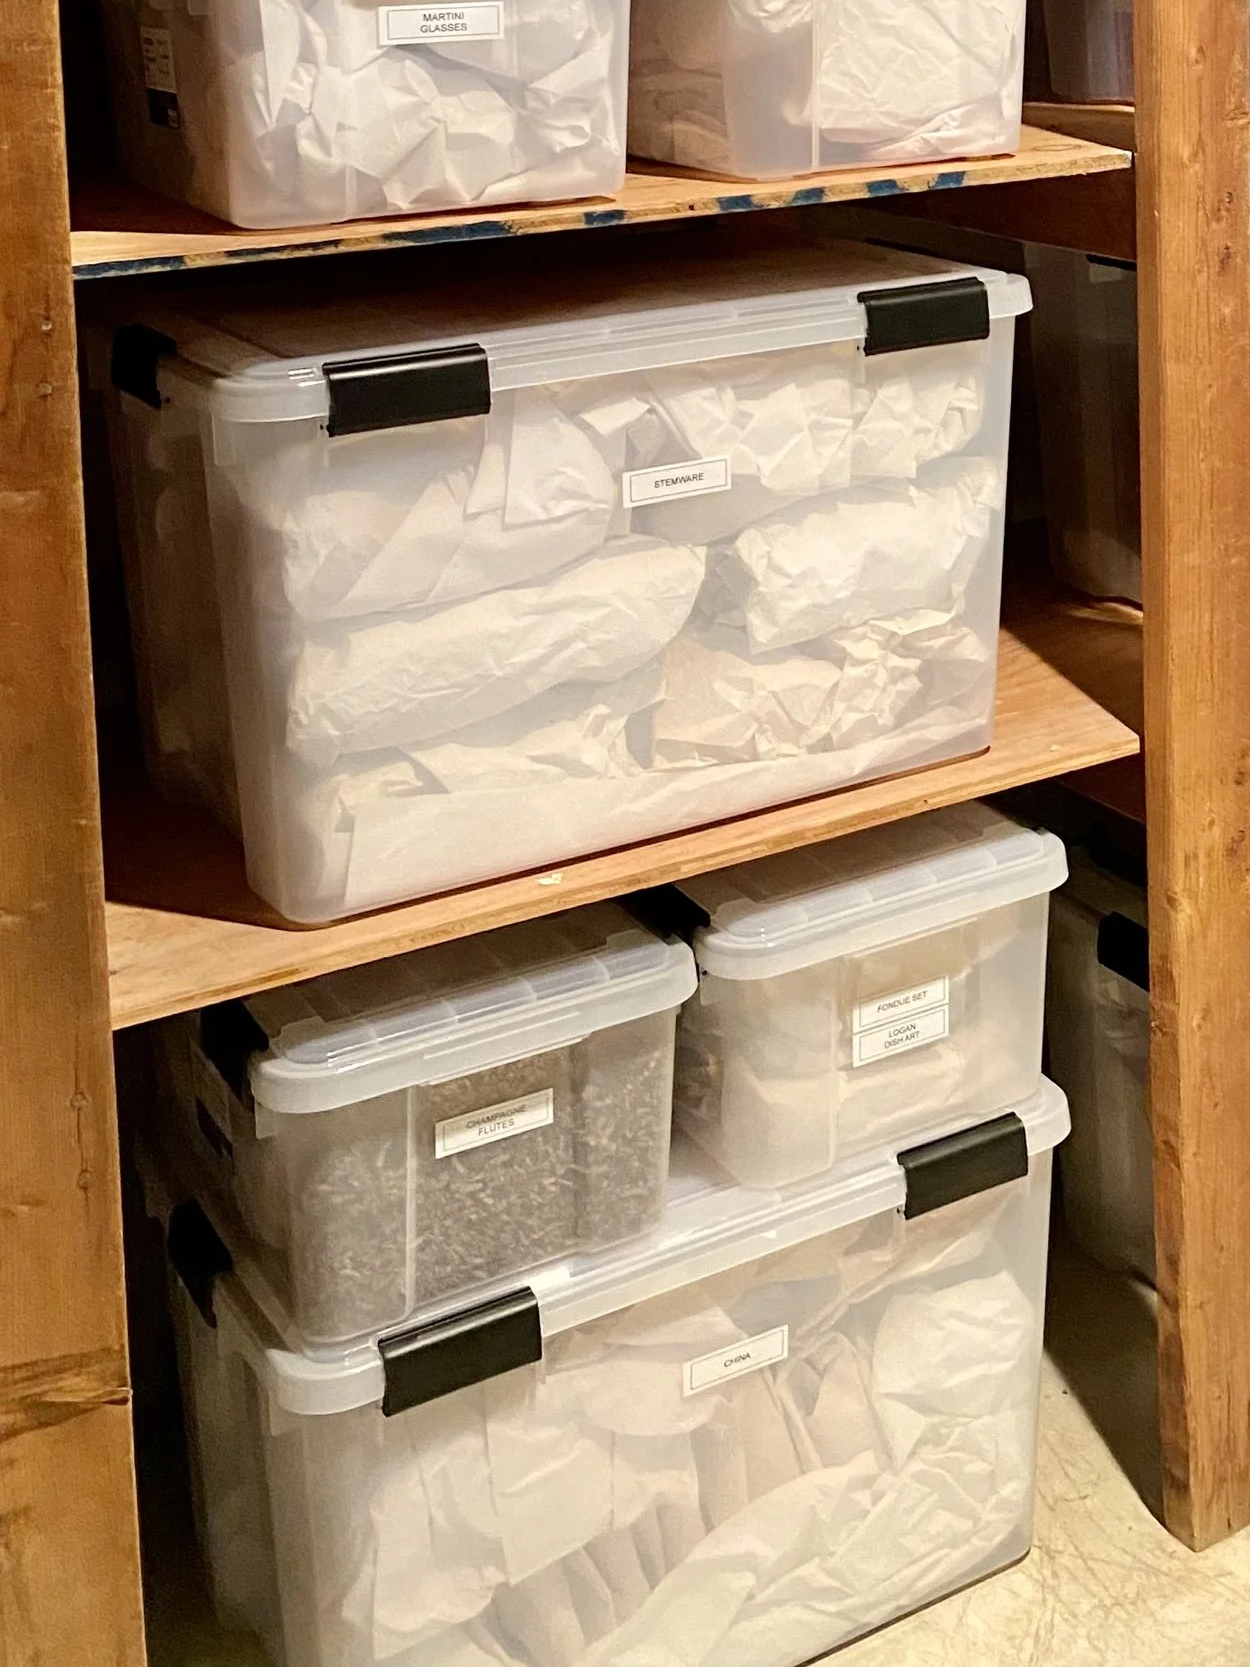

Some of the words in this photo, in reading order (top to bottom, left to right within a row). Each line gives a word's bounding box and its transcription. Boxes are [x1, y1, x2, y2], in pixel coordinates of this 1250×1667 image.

[422, 11, 465, 23] MARTINI
[420, 22, 467, 34] GLASSES
[653, 472, 704, 489] STEMWARE
[877, 994, 911, 1013] FONDUE
[911, 990, 928, 1003] SET
[888, 1022, 917, 1038] LOGAN
[884, 1035, 904, 1050] DISH
[904, 1030, 921, 1044] ART
[465, 1103, 527, 1129] CHAMPAGNE
[477, 1118, 515, 1136] FLUTES
[723, 1352, 751, 1368] CHINA
